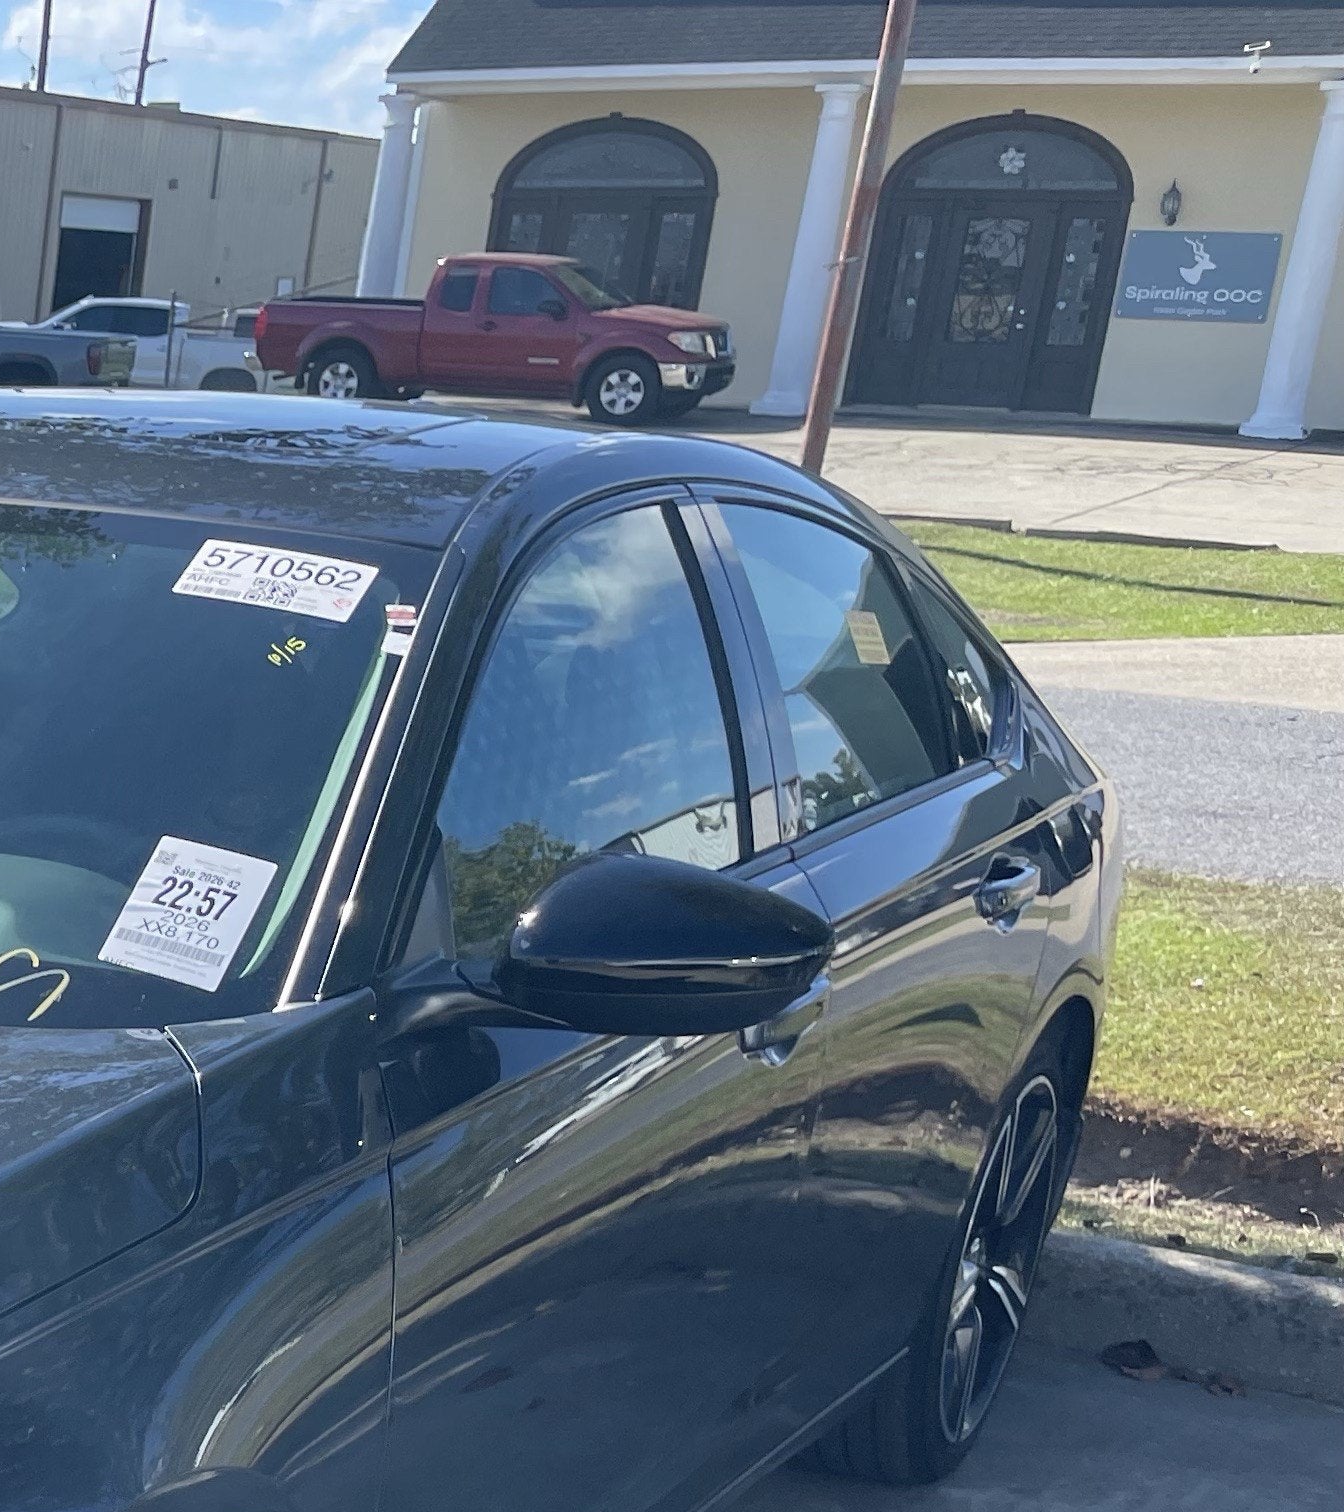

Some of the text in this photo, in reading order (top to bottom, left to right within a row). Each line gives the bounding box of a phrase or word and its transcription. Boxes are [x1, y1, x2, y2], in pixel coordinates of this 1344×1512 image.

[1125, 285, 1210, 305] Spiraling
[202, 547, 362, 592] 5710562
[172, 865, 196, 878] Sale
[198, 872, 225, 886] 2026
[227, 880, 241, 891] 42
[151, 875, 239, 921] 22:57
[160, 909, 211, 932] 2026
